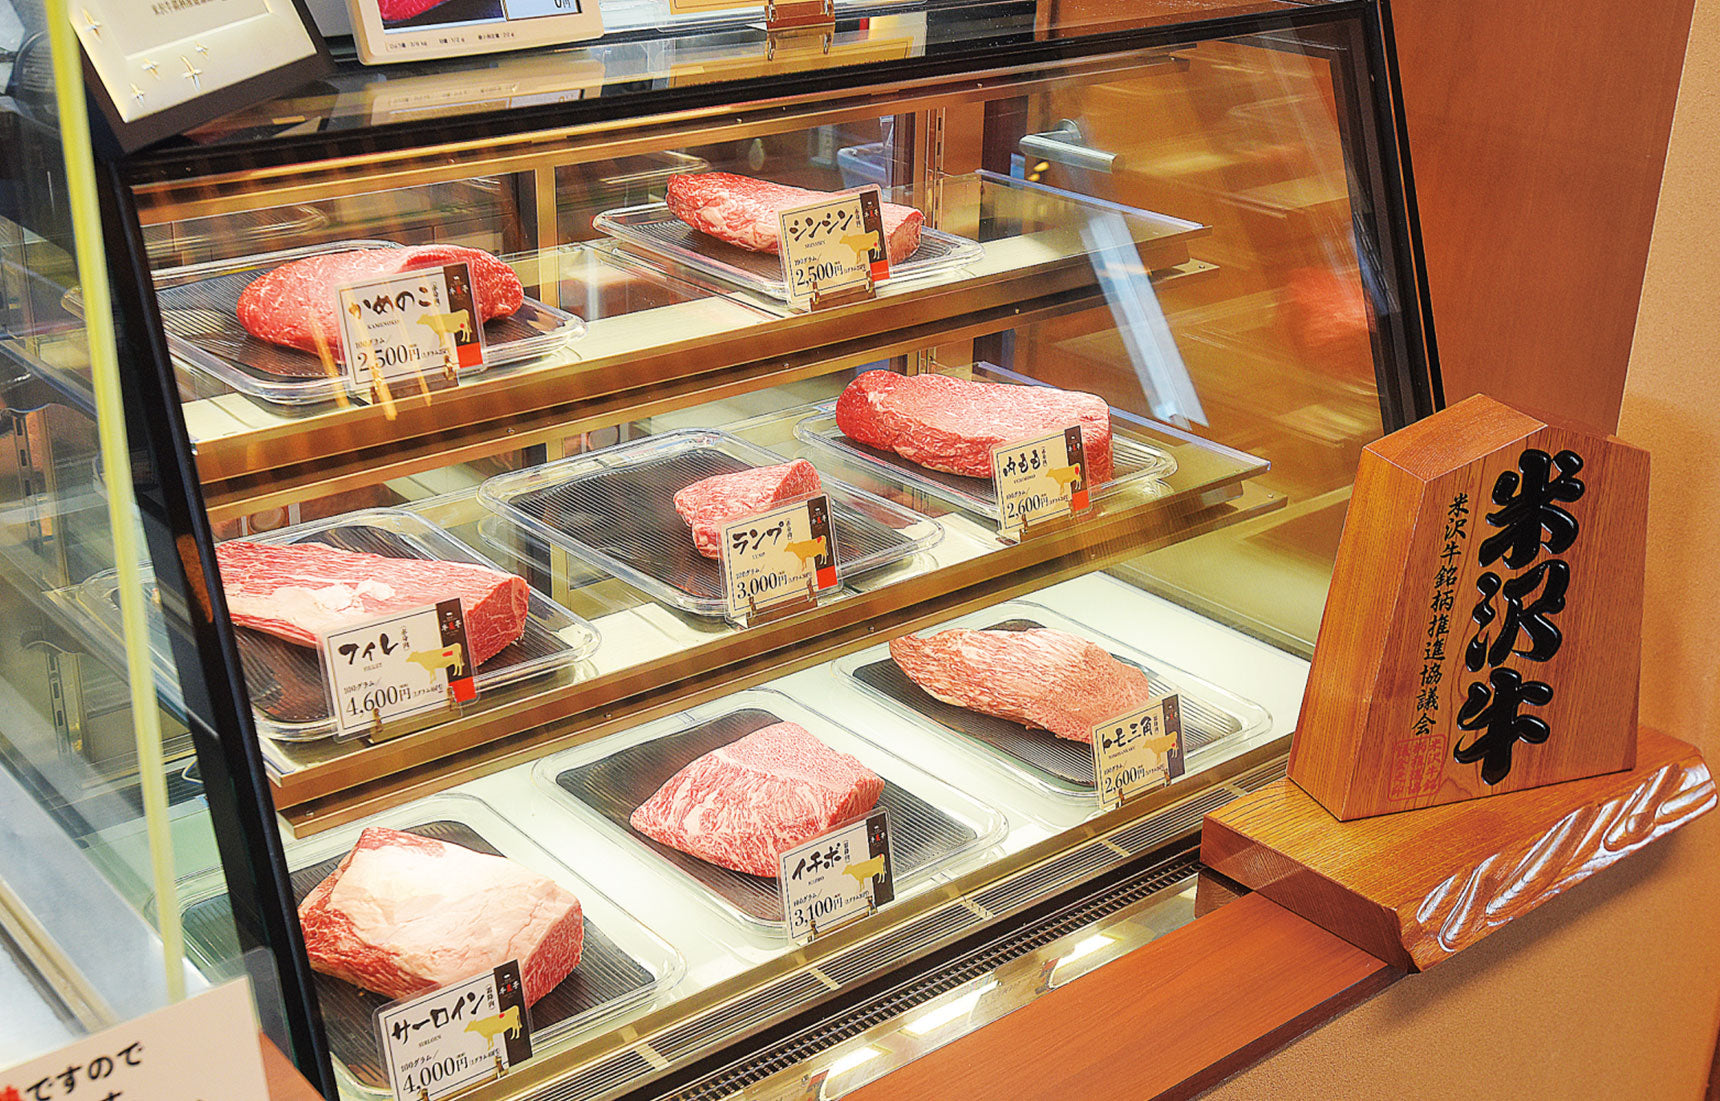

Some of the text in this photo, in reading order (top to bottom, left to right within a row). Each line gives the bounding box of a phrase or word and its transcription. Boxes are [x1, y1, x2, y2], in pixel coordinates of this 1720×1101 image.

[789, 210, 853, 242] シンシン
[795, 262, 843, 287] 2,500円
[348, 286, 432, 320] かめのこ
[1007, 494, 1048, 519] 2,600円
[732, 521, 784, 555] ランプ
[737, 572, 788, 600] 3,000円
[1411, 493, 1471, 736] 米沢牛銘柄推進協議会
[1453, 448, 1585, 785] 米沢牛
[346, 685, 411, 716] 4,600円
[1101, 716, 1153, 754] トモ三角
[1105, 766, 1145, 794] 2,600円
[792, 842, 842, 881] イチボ
[794, 896, 843, 927] 3,100円
[391, 992, 485, 1045] サーロイン
[25, 1041, 145, 1101] ですので
[403, 1055, 469, 1095] 4,000円
